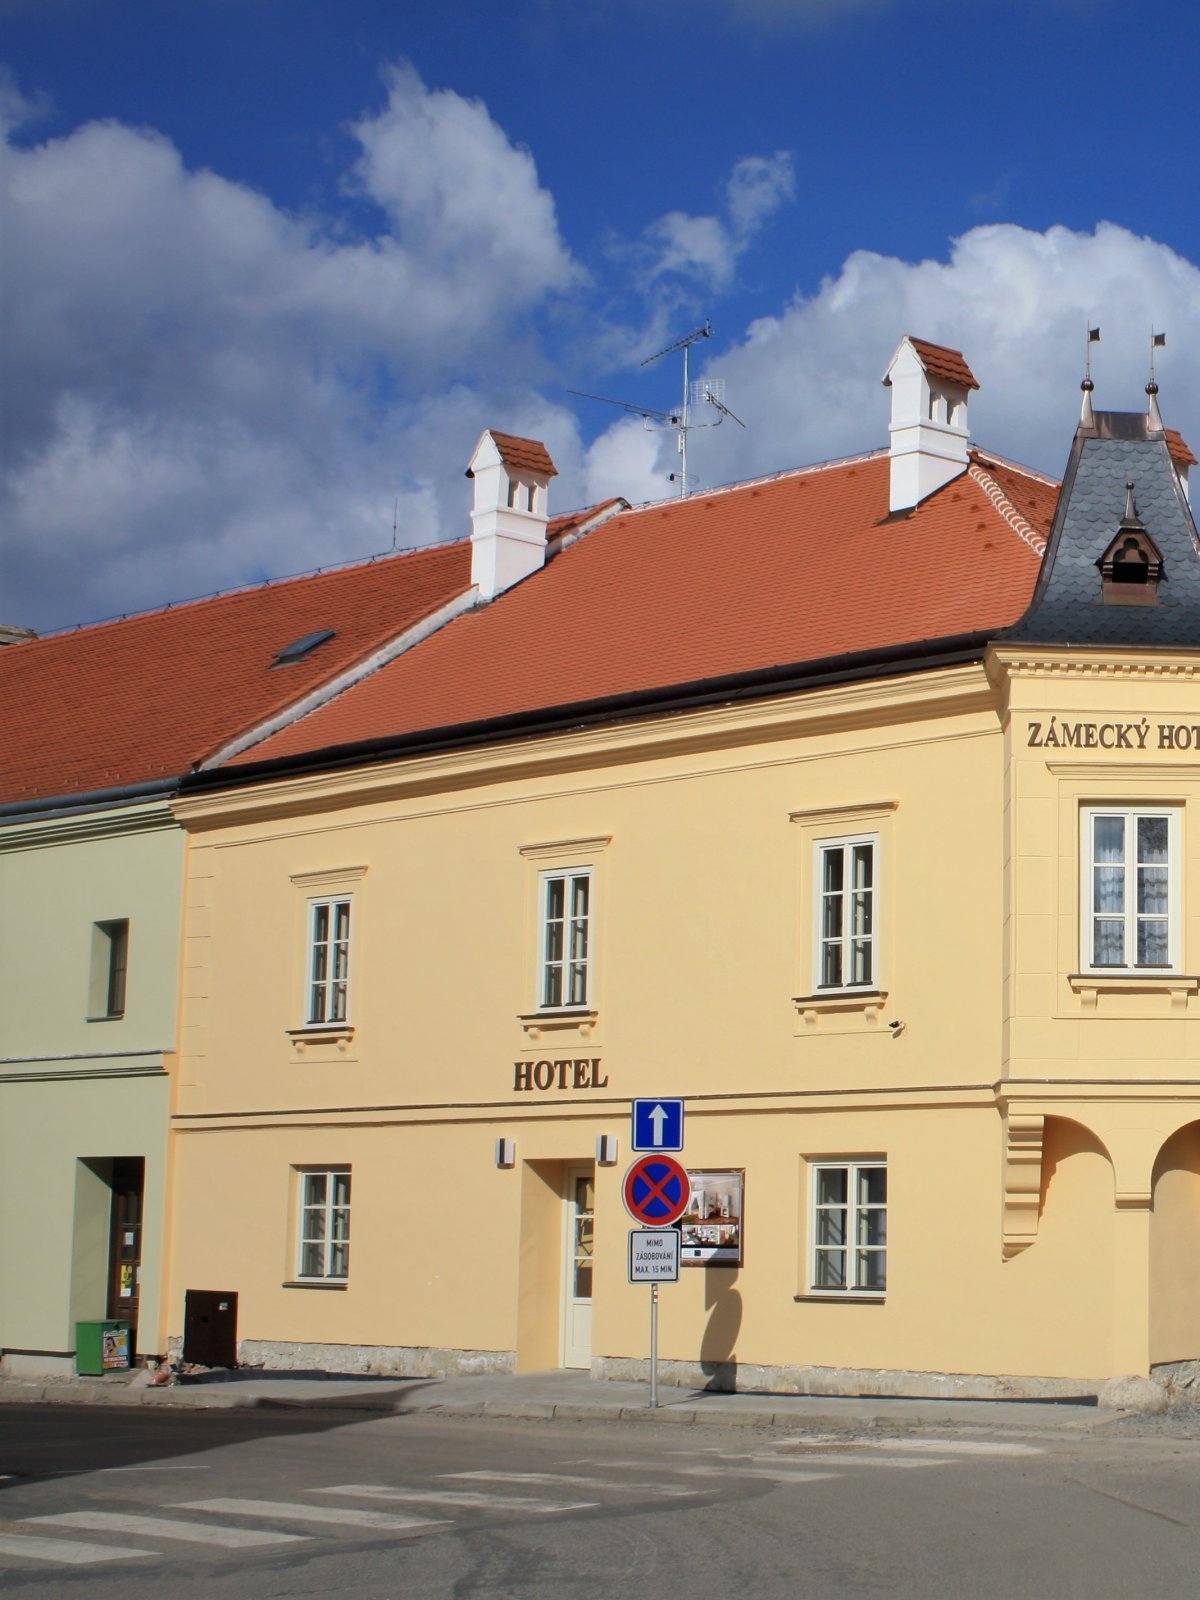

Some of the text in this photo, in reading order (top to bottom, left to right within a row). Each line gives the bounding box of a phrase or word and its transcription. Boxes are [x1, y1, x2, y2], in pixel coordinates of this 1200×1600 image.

[1027, 716, 1150, 749] ZÁMECKÝ
[513, 1058, 609, 1091] HOTEL
[646, 1239, 664, 1247] MIMO
[652, 1265, 659, 1273] 15
